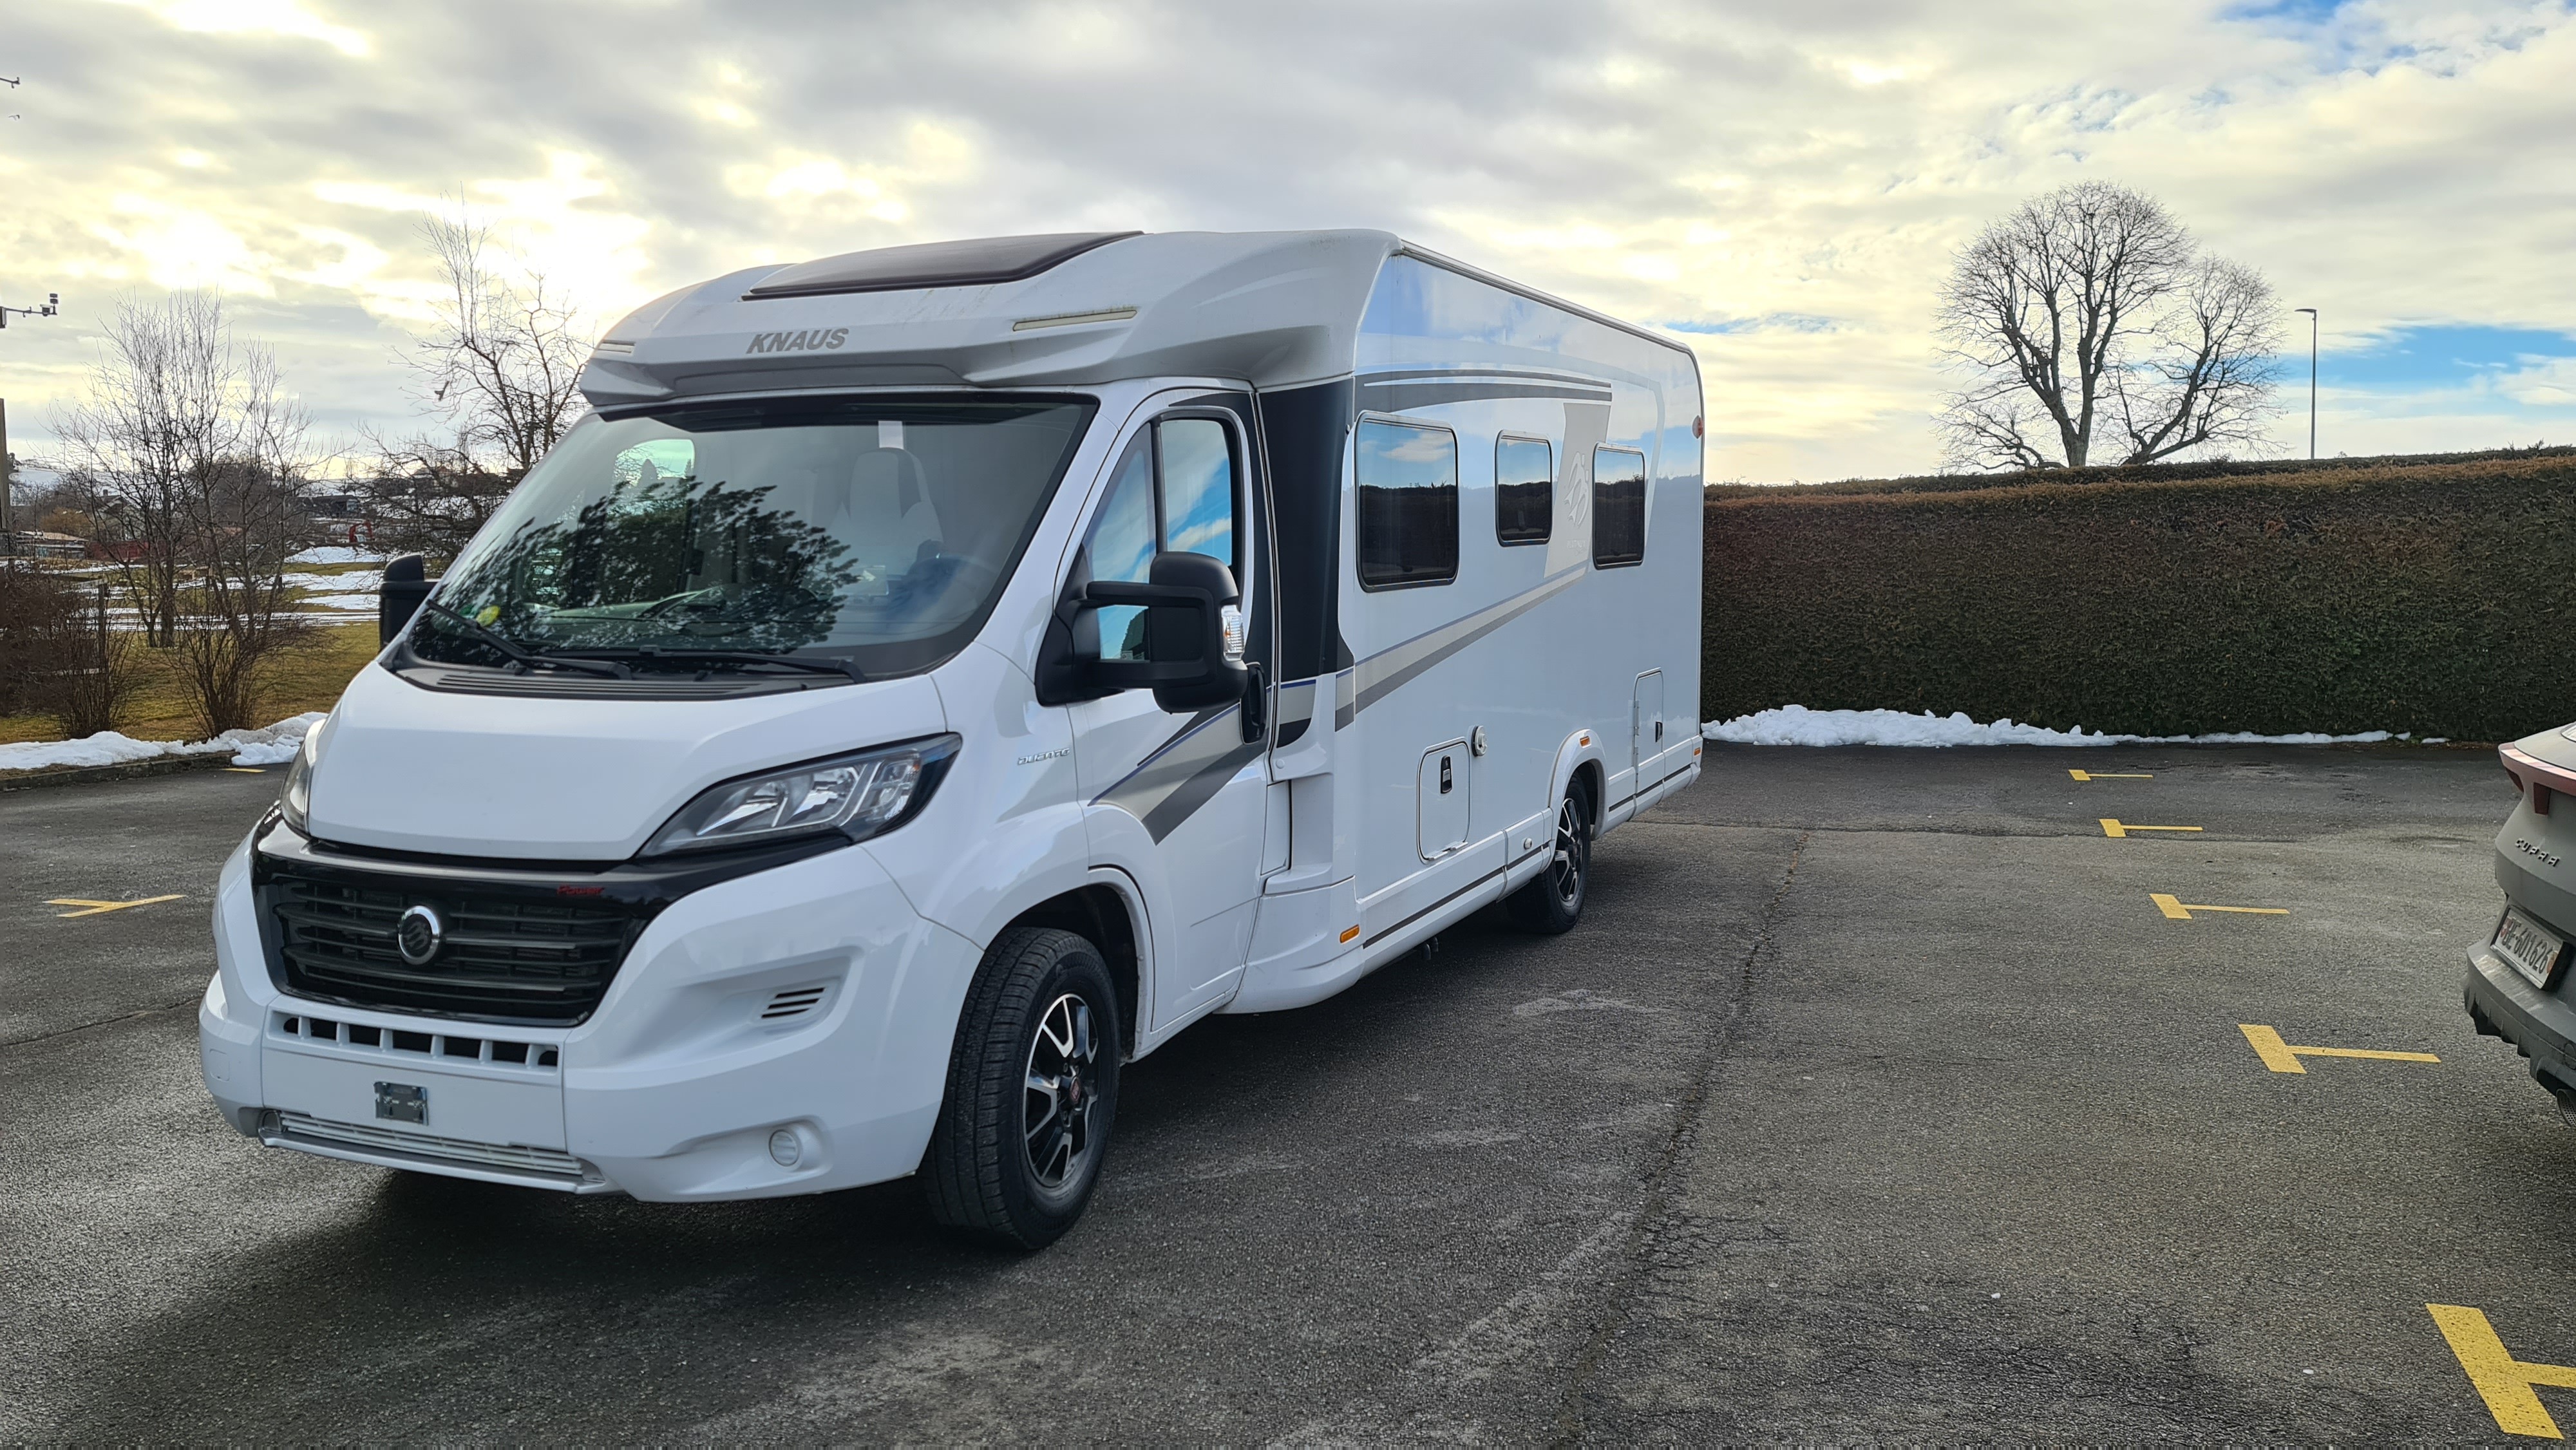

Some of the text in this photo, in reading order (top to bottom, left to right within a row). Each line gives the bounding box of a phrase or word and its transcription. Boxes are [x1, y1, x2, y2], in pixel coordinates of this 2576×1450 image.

[745, 328, 849, 354] KNAUS
[1018, 748, 1070, 765] DUCATO
[2515, 838, 2560, 867] CUPRA
